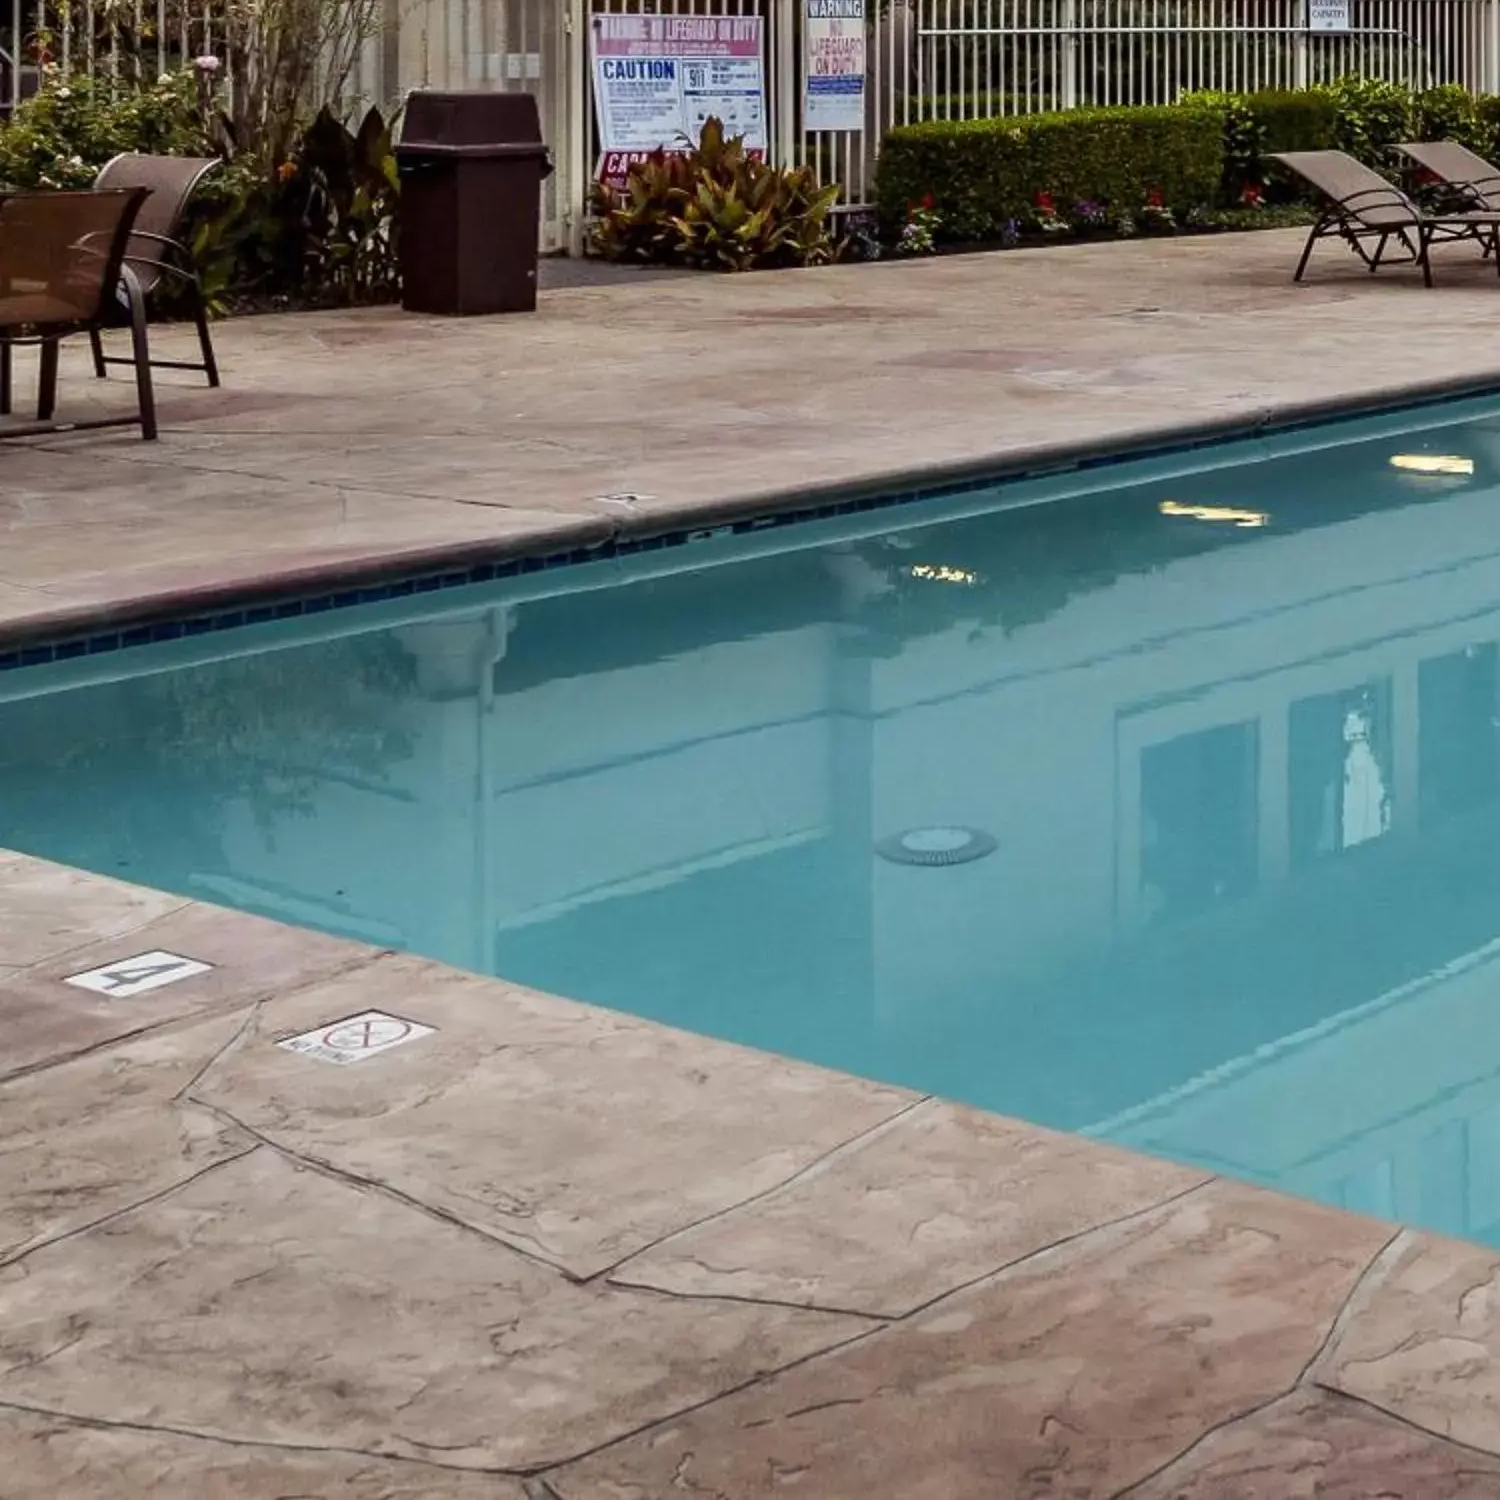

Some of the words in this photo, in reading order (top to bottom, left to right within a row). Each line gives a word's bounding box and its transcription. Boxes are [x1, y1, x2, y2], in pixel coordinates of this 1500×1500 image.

[666, 19, 717, 41] LIFEGUARD
[603, 60, 675, 80] CAUTION
[689, 68, 705, 87] 911
[101, 962, 187, 990] 4
